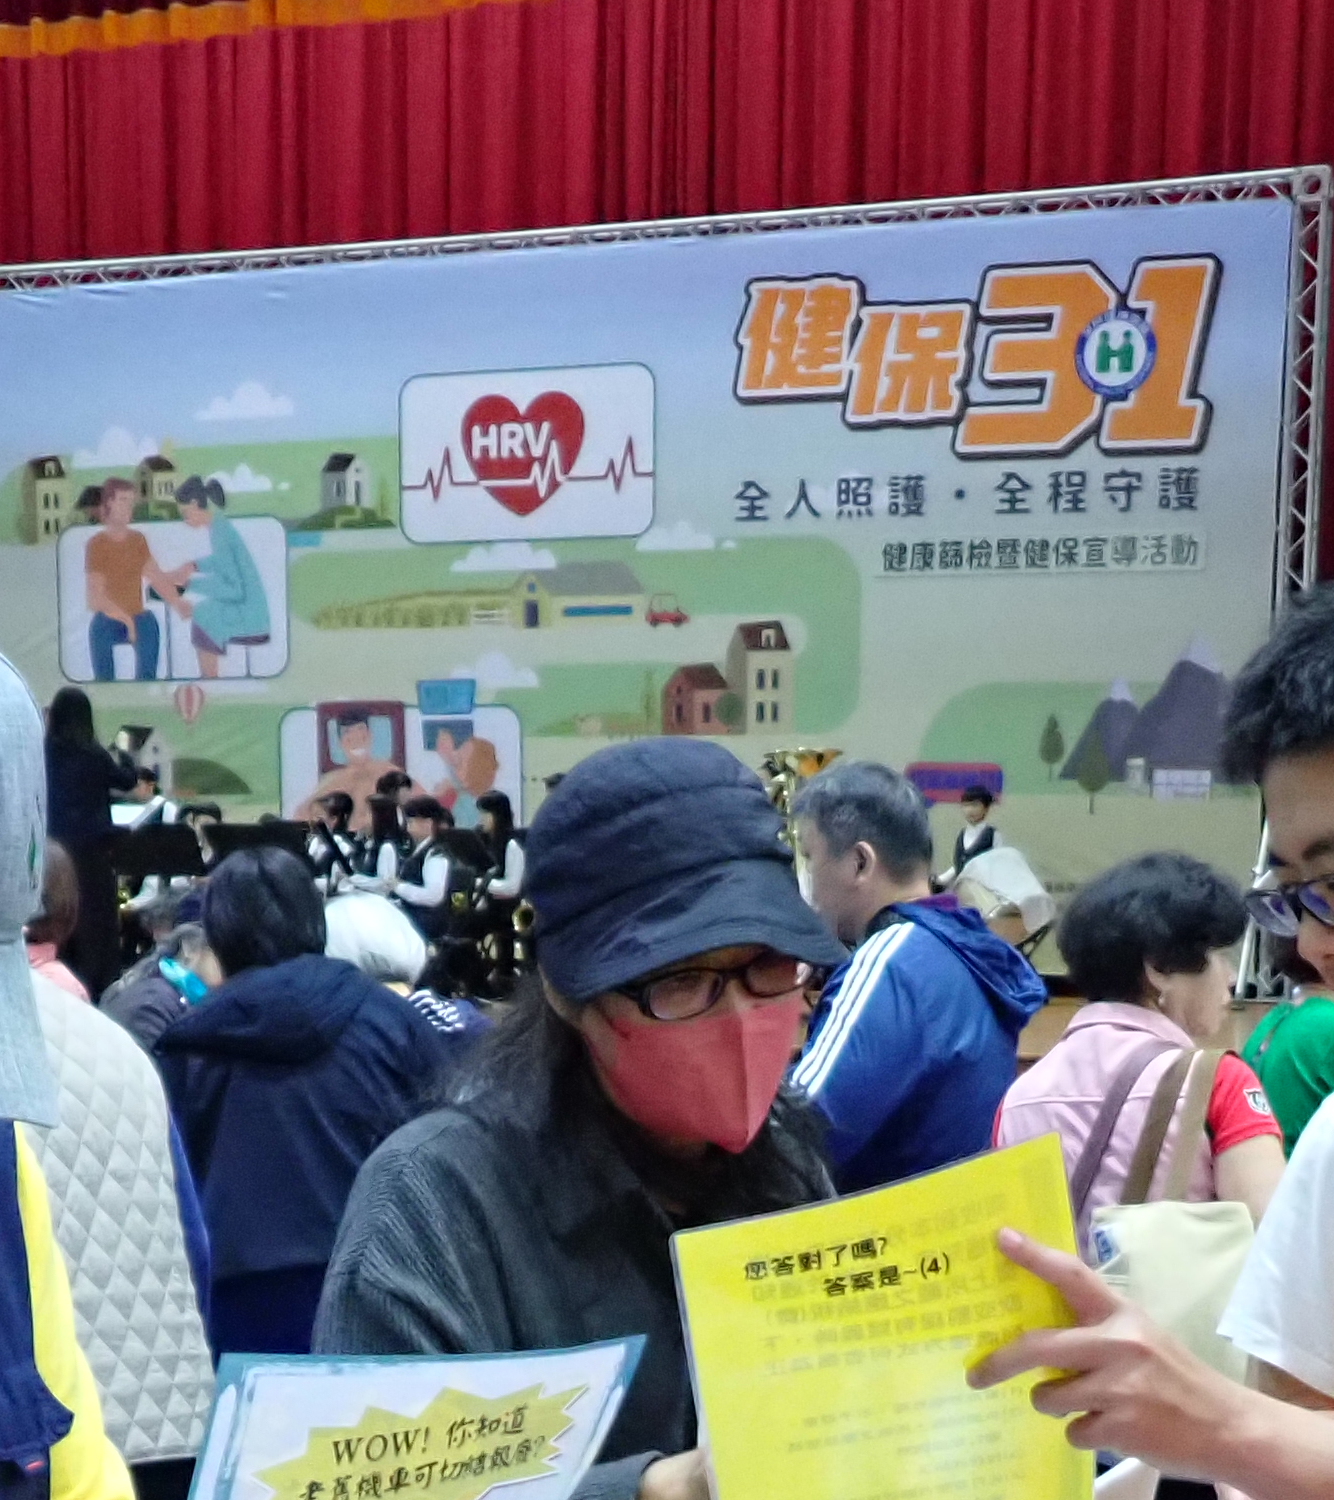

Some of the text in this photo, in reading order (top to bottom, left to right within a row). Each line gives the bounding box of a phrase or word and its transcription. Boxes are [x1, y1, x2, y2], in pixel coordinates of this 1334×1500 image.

[471, 420, 551, 459] HRV
[331, 1403, 529, 1466] WOW! 你知道
